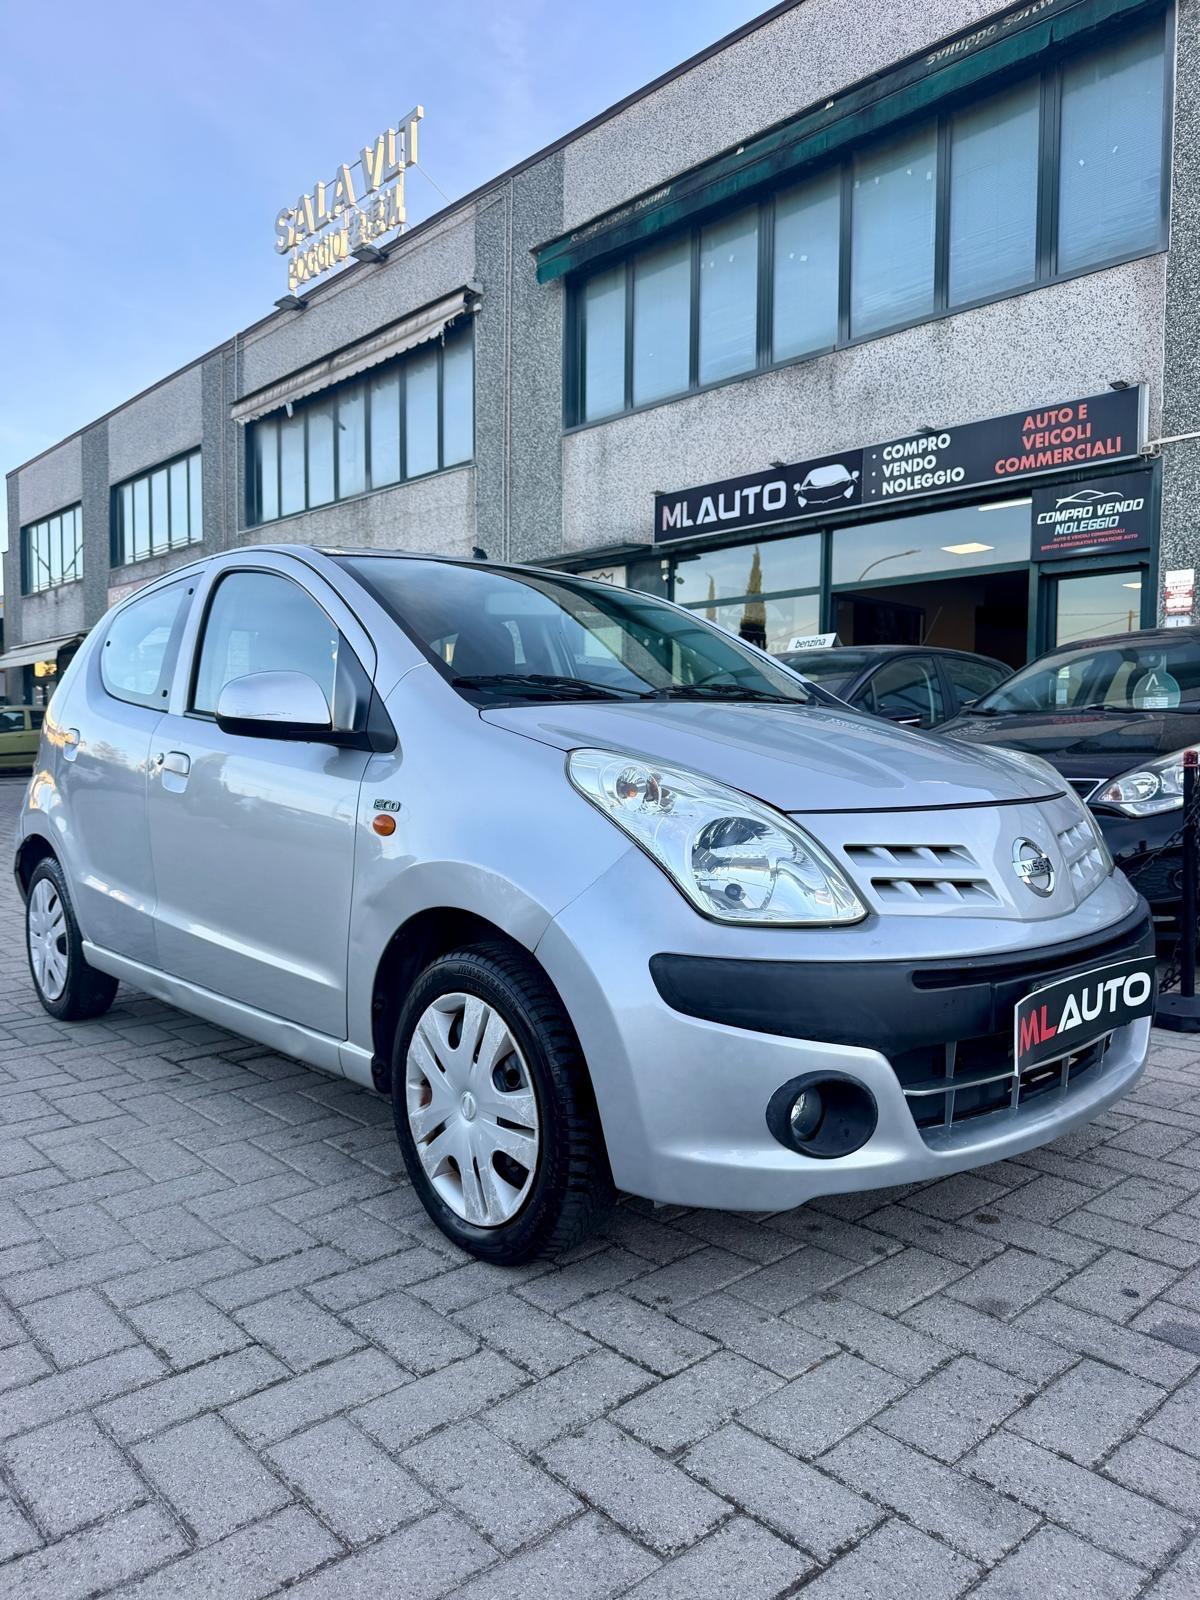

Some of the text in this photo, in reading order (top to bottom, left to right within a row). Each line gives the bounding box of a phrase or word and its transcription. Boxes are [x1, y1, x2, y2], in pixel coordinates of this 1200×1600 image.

[274, 163, 356, 255] SALA
[360, 105, 425, 194] VLT
[1022, 403, 1088, 432] AUTO E
[882, 433, 951, 461] COMPRO
[1021, 422, 1092, 451] VEICOLI
[881, 454, 937, 478] VENDO
[994, 436, 1122, 475] COMMERCIALI
[881, 466, 965, 496] NOLEGGIO
[1037, 498, 1144, 525] COMPRO VENDO
[1054, 515, 1119, 535] NOLEGGIO
[795, 637, 826, 649] benzina
